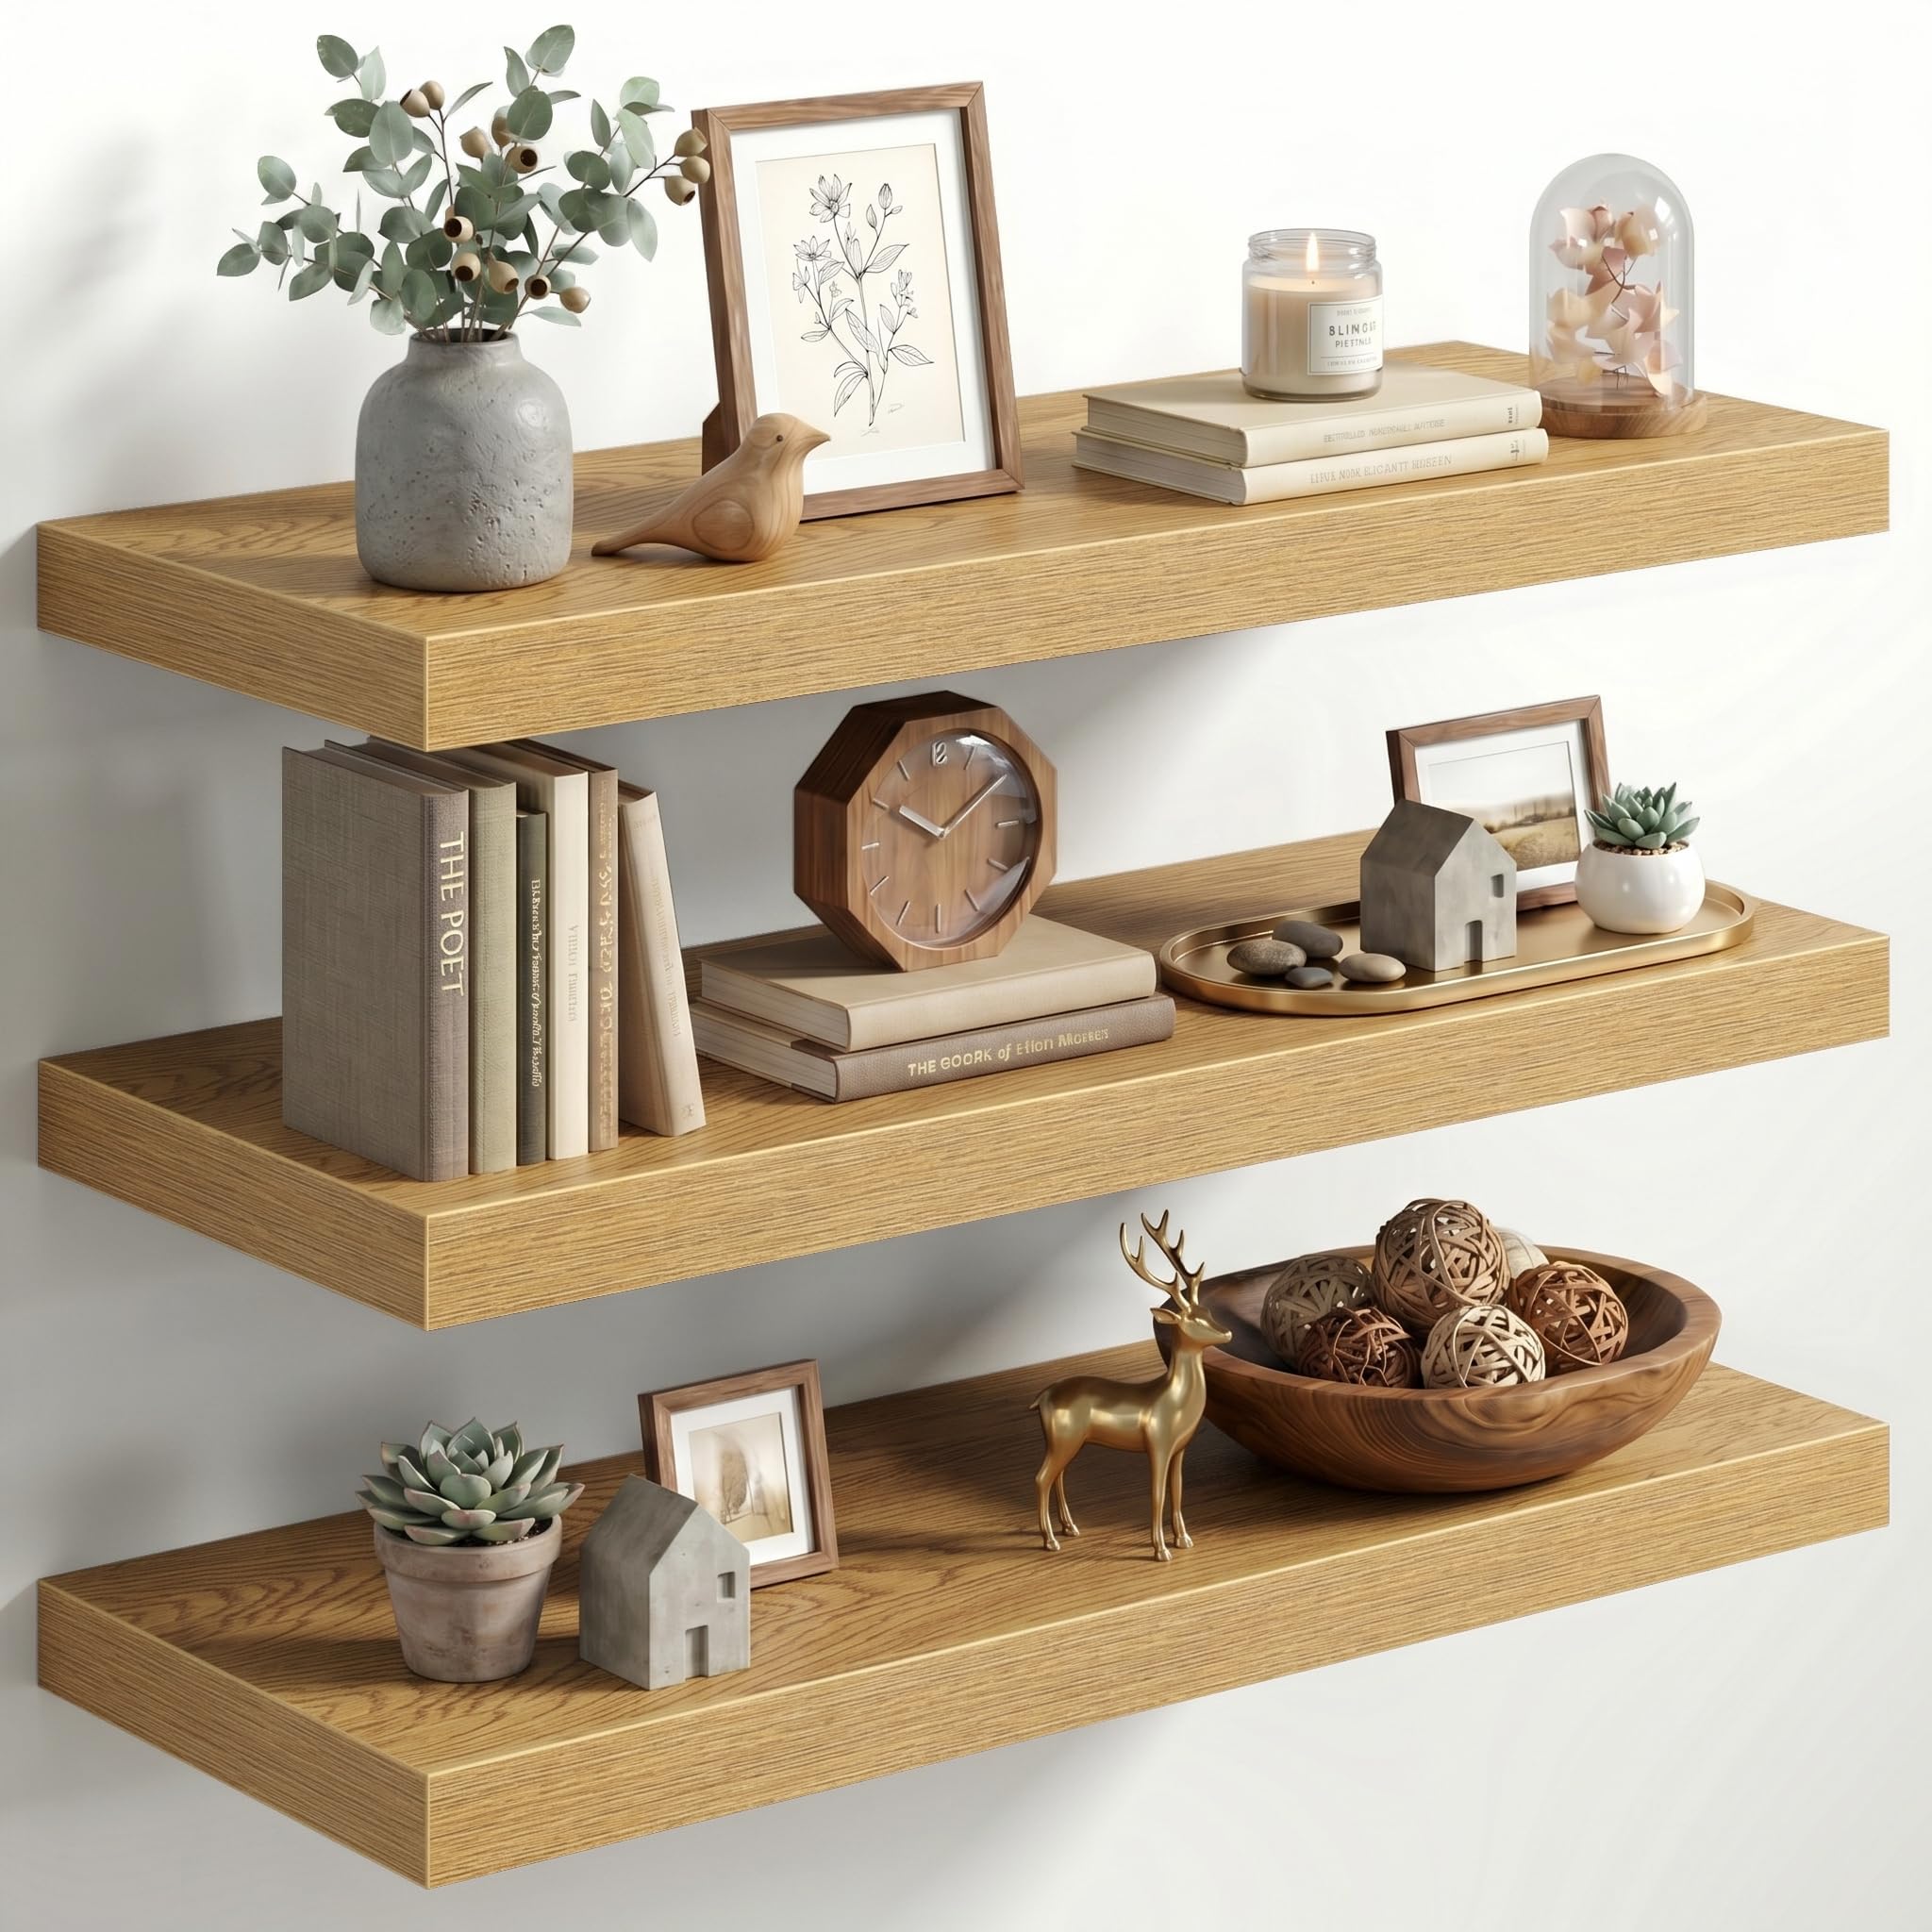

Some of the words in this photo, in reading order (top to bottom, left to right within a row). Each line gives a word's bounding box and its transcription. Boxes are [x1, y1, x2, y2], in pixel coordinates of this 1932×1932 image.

[441, 831, 464, 901] THE
[441, 910, 464, 996] POET
[908, 1059, 937, 1076] THE
[998, 1043, 1012, 1061] of
